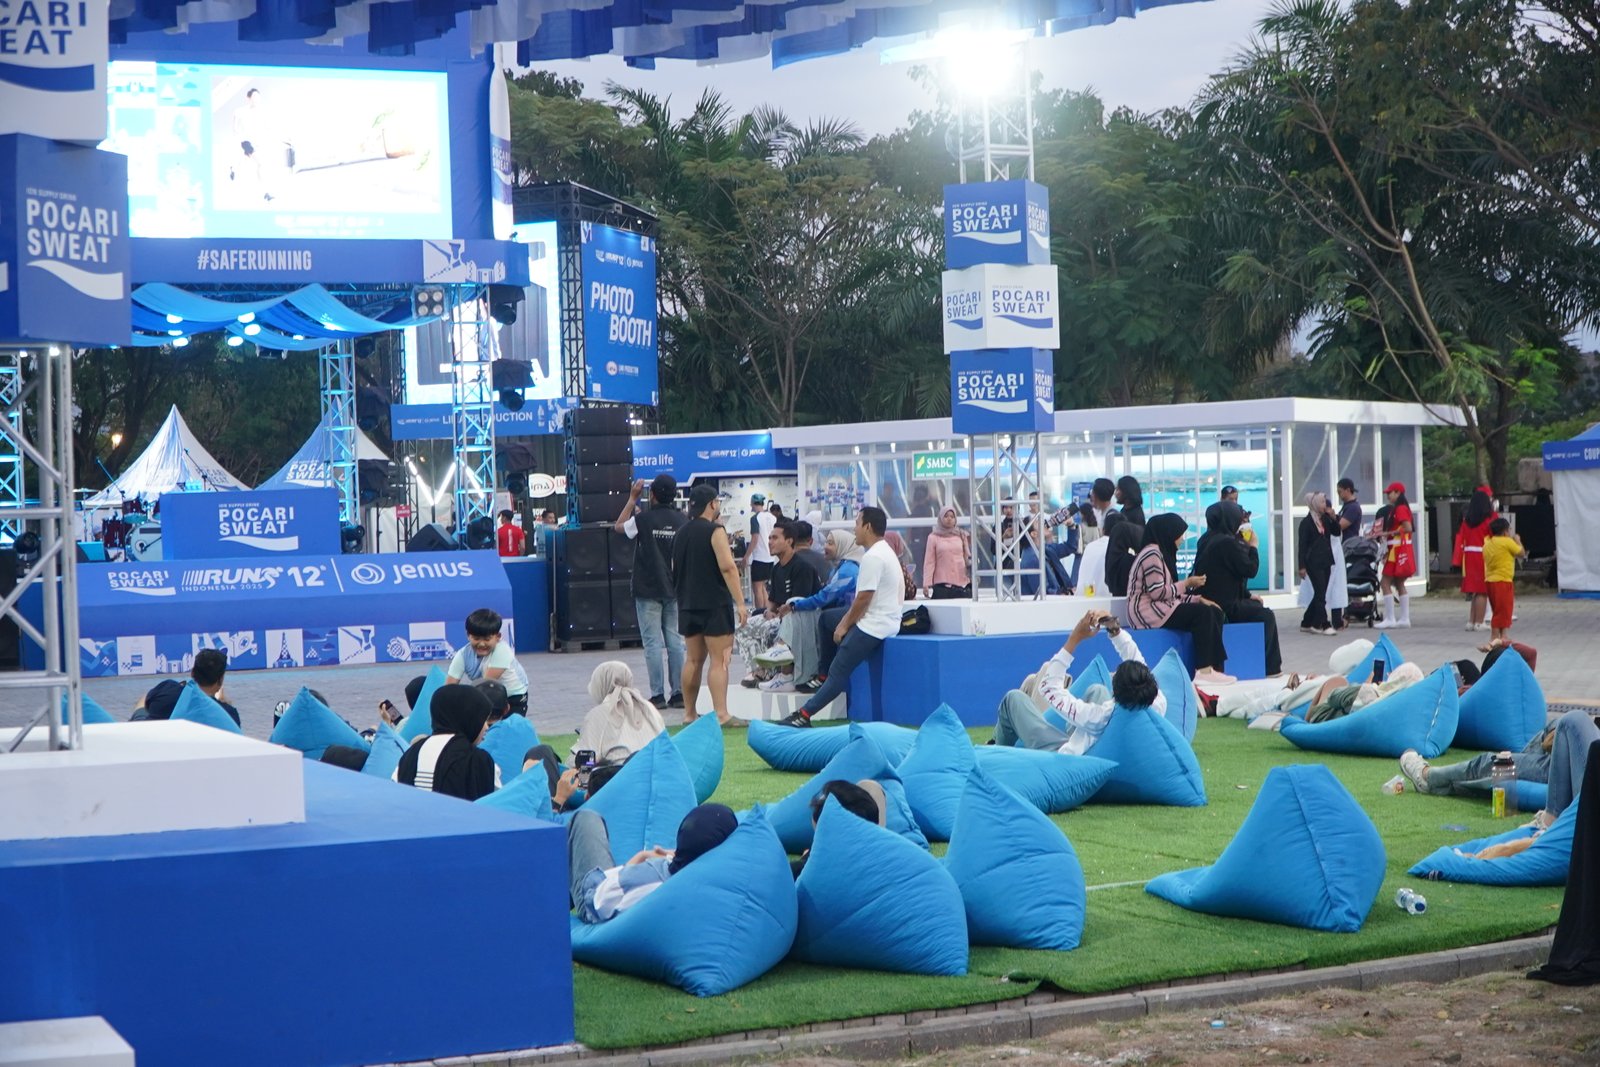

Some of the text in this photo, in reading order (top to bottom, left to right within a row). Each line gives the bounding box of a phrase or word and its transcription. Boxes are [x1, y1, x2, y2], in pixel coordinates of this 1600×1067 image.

[26, 198, 118, 236] POCARI
[952, 204, 1018, 221] POCARI
[1028, 204, 1048, 223] POCARI
[952, 217, 1012, 233] SWEAT
[1028, 217, 1046, 233] SWEAT
[27, 228, 110, 263] SWEAT
[197, 249, 312, 270] #SAFERUNNING
[591, 281, 634, 315] PHOTO
[946, 291, 981, 307] POCARI
[992, 290, 1050, 302] POCARI
[947, 304, 978, 319] SWEAT
[993, 302, 1045, 314] SWEAT
[609, 313, 652, 347] BOOTH
[958, 373, 1024, 388] POCARI
[958, 386, 1018, 400] SWEAT
[1035, 385, 1051, 398] SWEAT
[633, 454, 673, 466] astra life
[926, 456, 953, 469] SMBC
[219, 507, 294, 522] POCARI
[220, 520, 287, 536] SWEAT
[108, 570, 169, 579] POCARI
[110, 578, 165, 588] SWEAT
